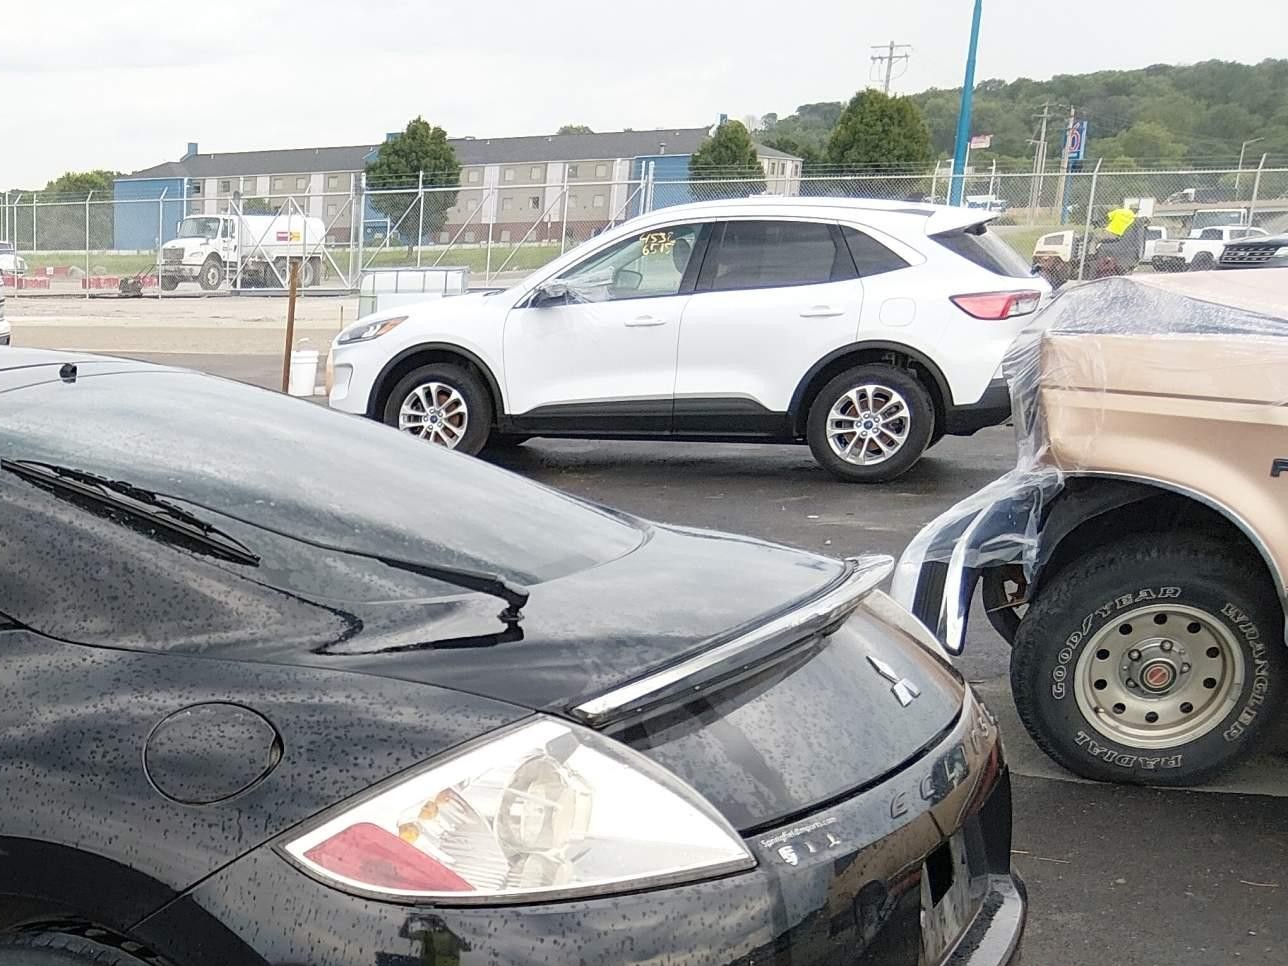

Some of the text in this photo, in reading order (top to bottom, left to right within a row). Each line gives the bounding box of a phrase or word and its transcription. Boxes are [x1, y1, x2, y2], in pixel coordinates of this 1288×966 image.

[1052, 586, 1182, 700] GOODYEAR
[1220, 602, 1270, 742] WRANGLER
[1073, 730, 1183, 770] RADIAL
